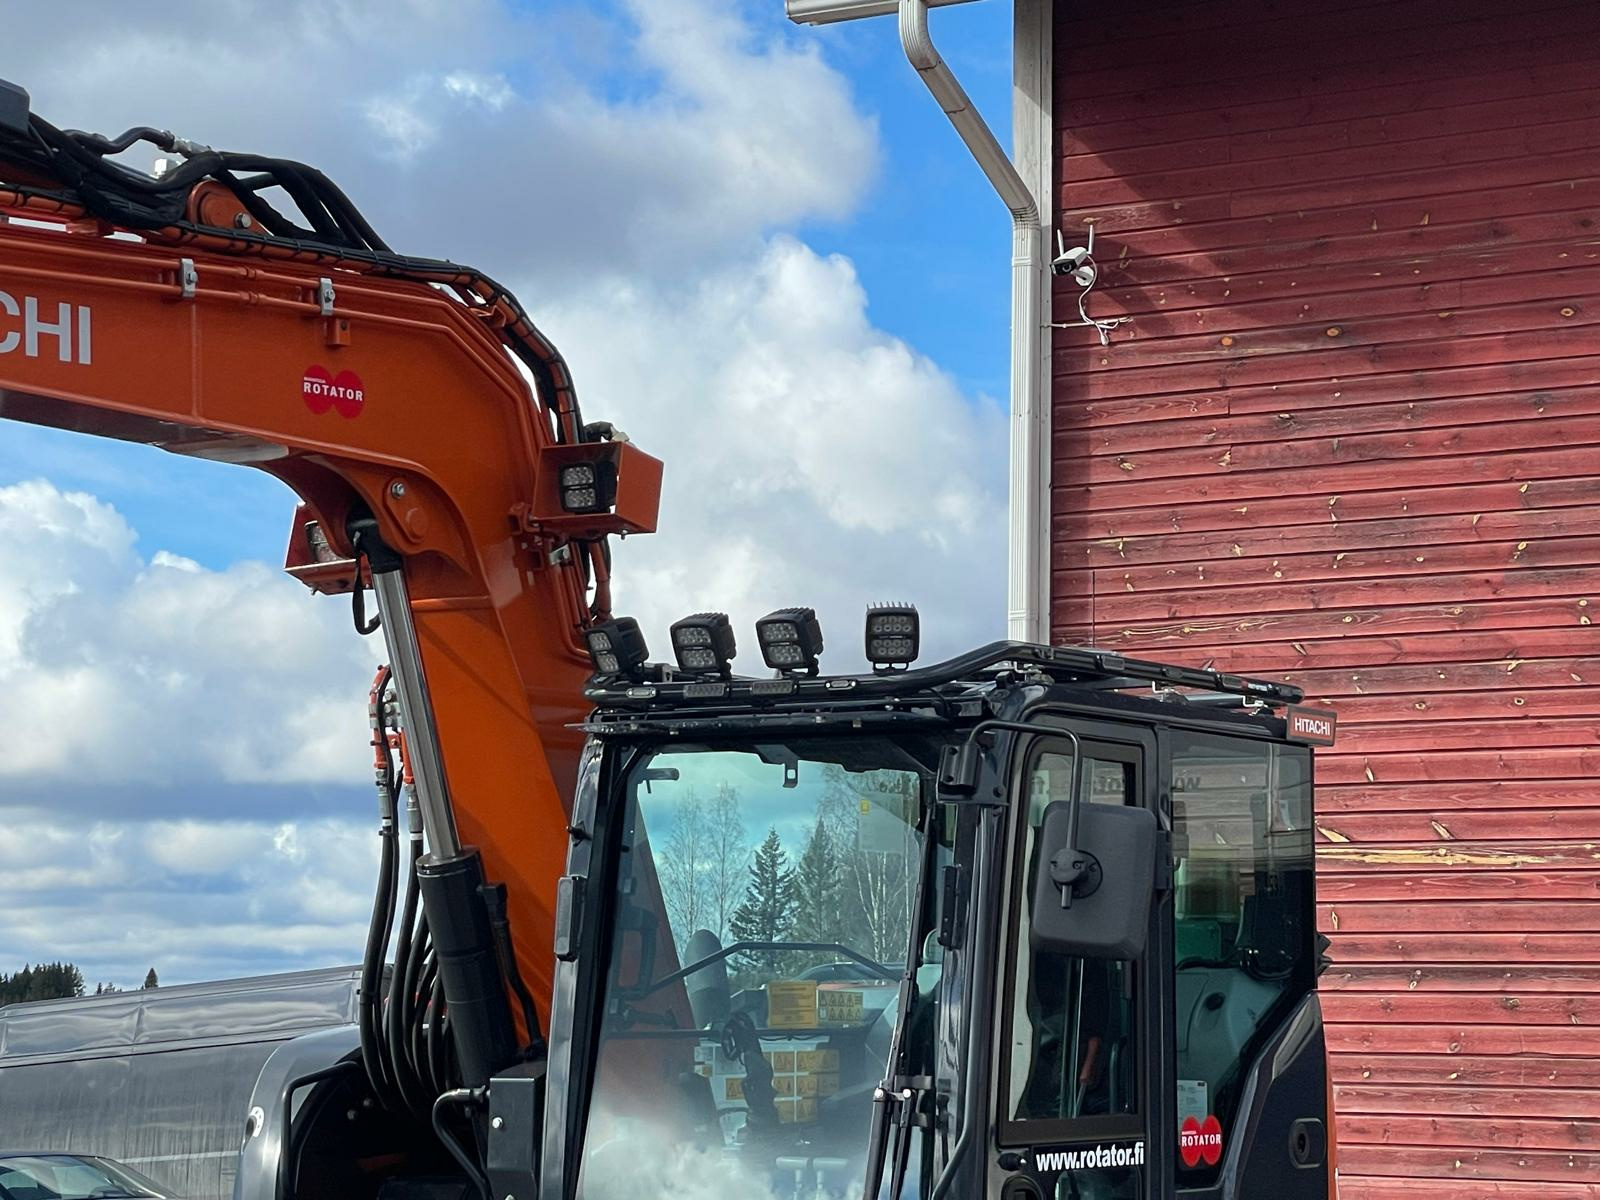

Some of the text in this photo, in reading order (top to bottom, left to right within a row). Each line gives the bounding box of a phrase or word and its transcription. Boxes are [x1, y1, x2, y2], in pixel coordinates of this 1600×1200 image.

[303, 382, 363, 401] ROTATOR
[1294, 718, 1331, 735] HITACHI
[1181, 1134, 1221, 1147] ROTATOR
[1036, 1141, 1144, 1172] www.rotator.fi
